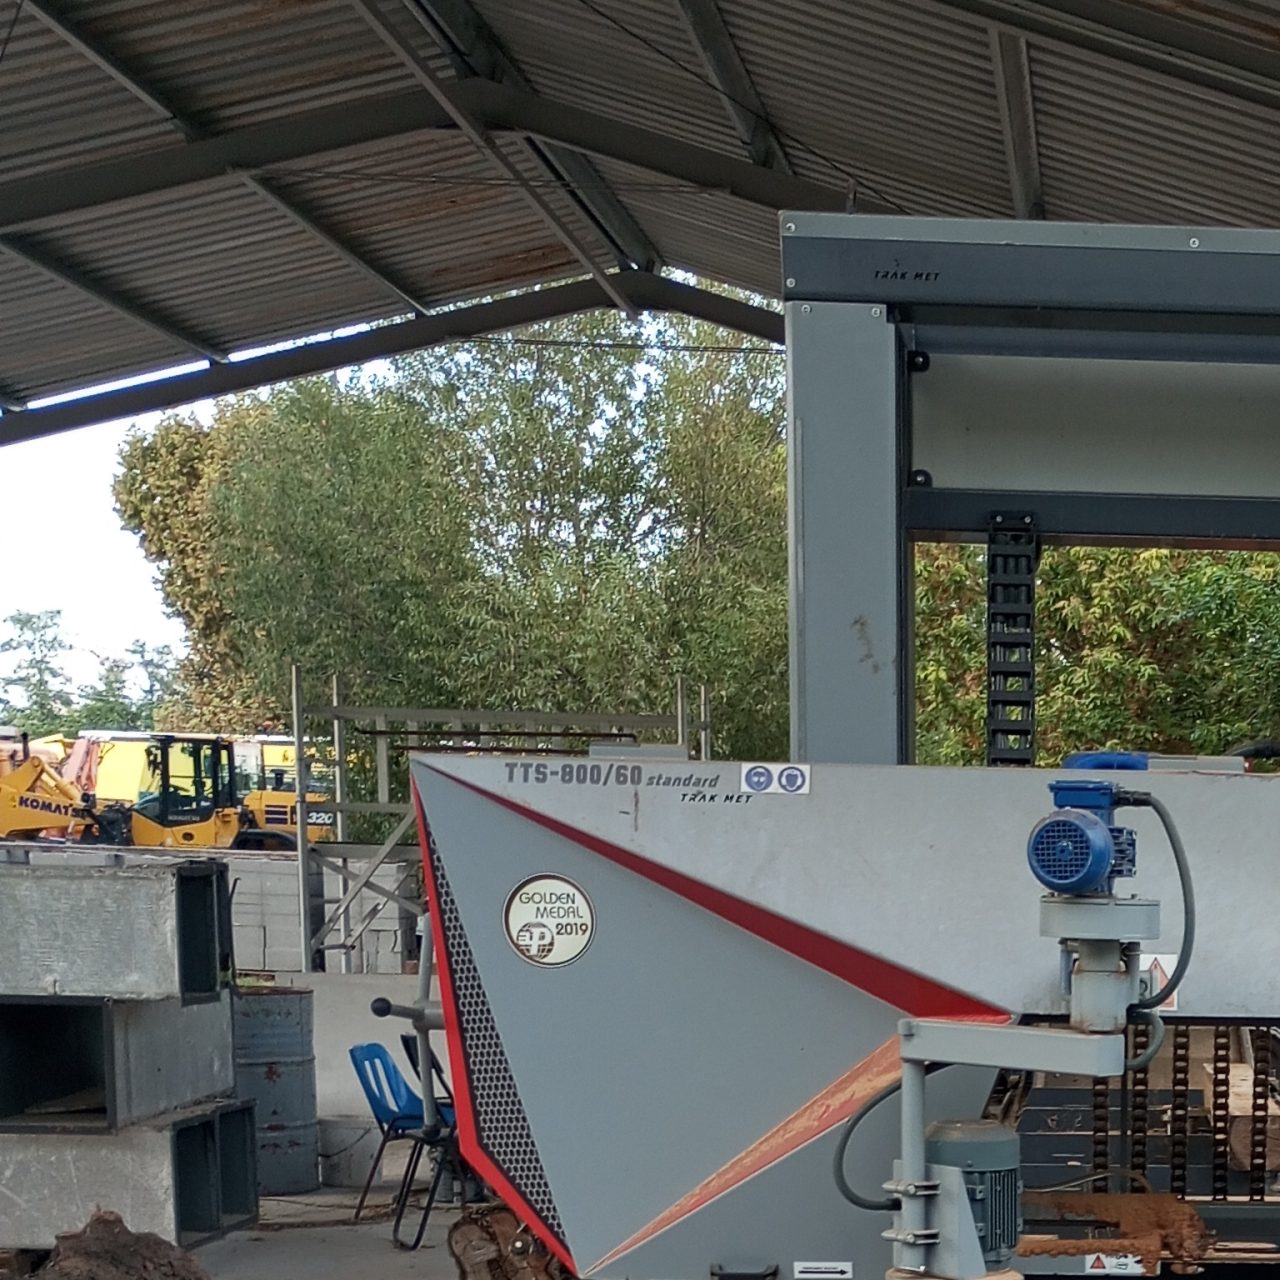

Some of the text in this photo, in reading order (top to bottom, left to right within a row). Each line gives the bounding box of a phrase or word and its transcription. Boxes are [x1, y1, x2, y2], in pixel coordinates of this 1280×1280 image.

[913, 271, 941, 281] MET
[504, 762, 721, 789] TTS-800/60 standard
[680, 793, 754, 805] TRAK MET
[519, 892, 576, 905] GOLDEN
[535, 906, 584, 919] MEDAL
[555, 922, 589, 936] 2019
